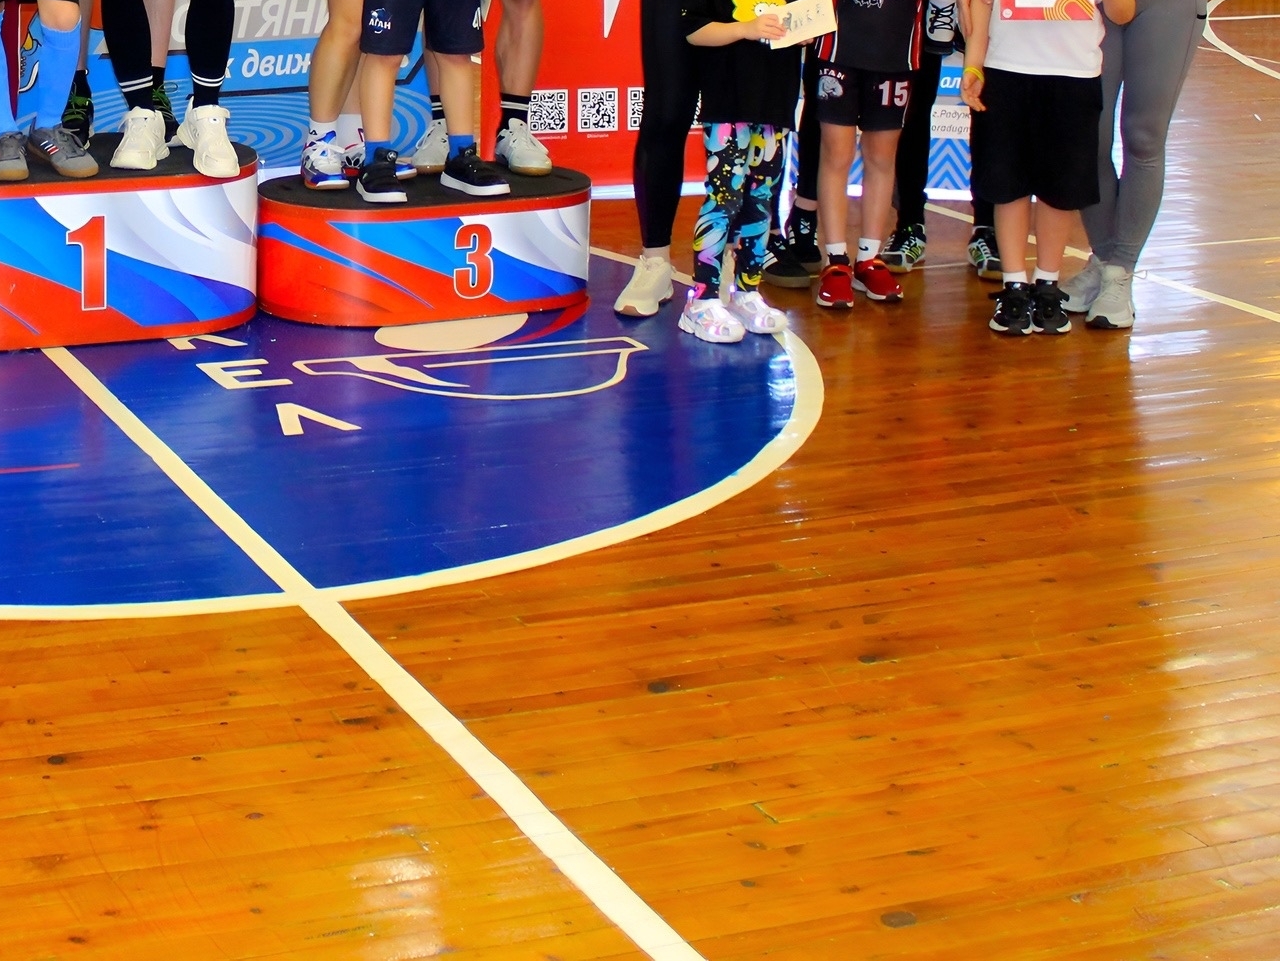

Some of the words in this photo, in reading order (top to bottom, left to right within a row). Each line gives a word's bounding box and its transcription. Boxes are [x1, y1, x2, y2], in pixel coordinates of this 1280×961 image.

[878, 80, 909, 107] 15
[65, 216, 108, 313] 1
[453, 223, 494, 300] 3
